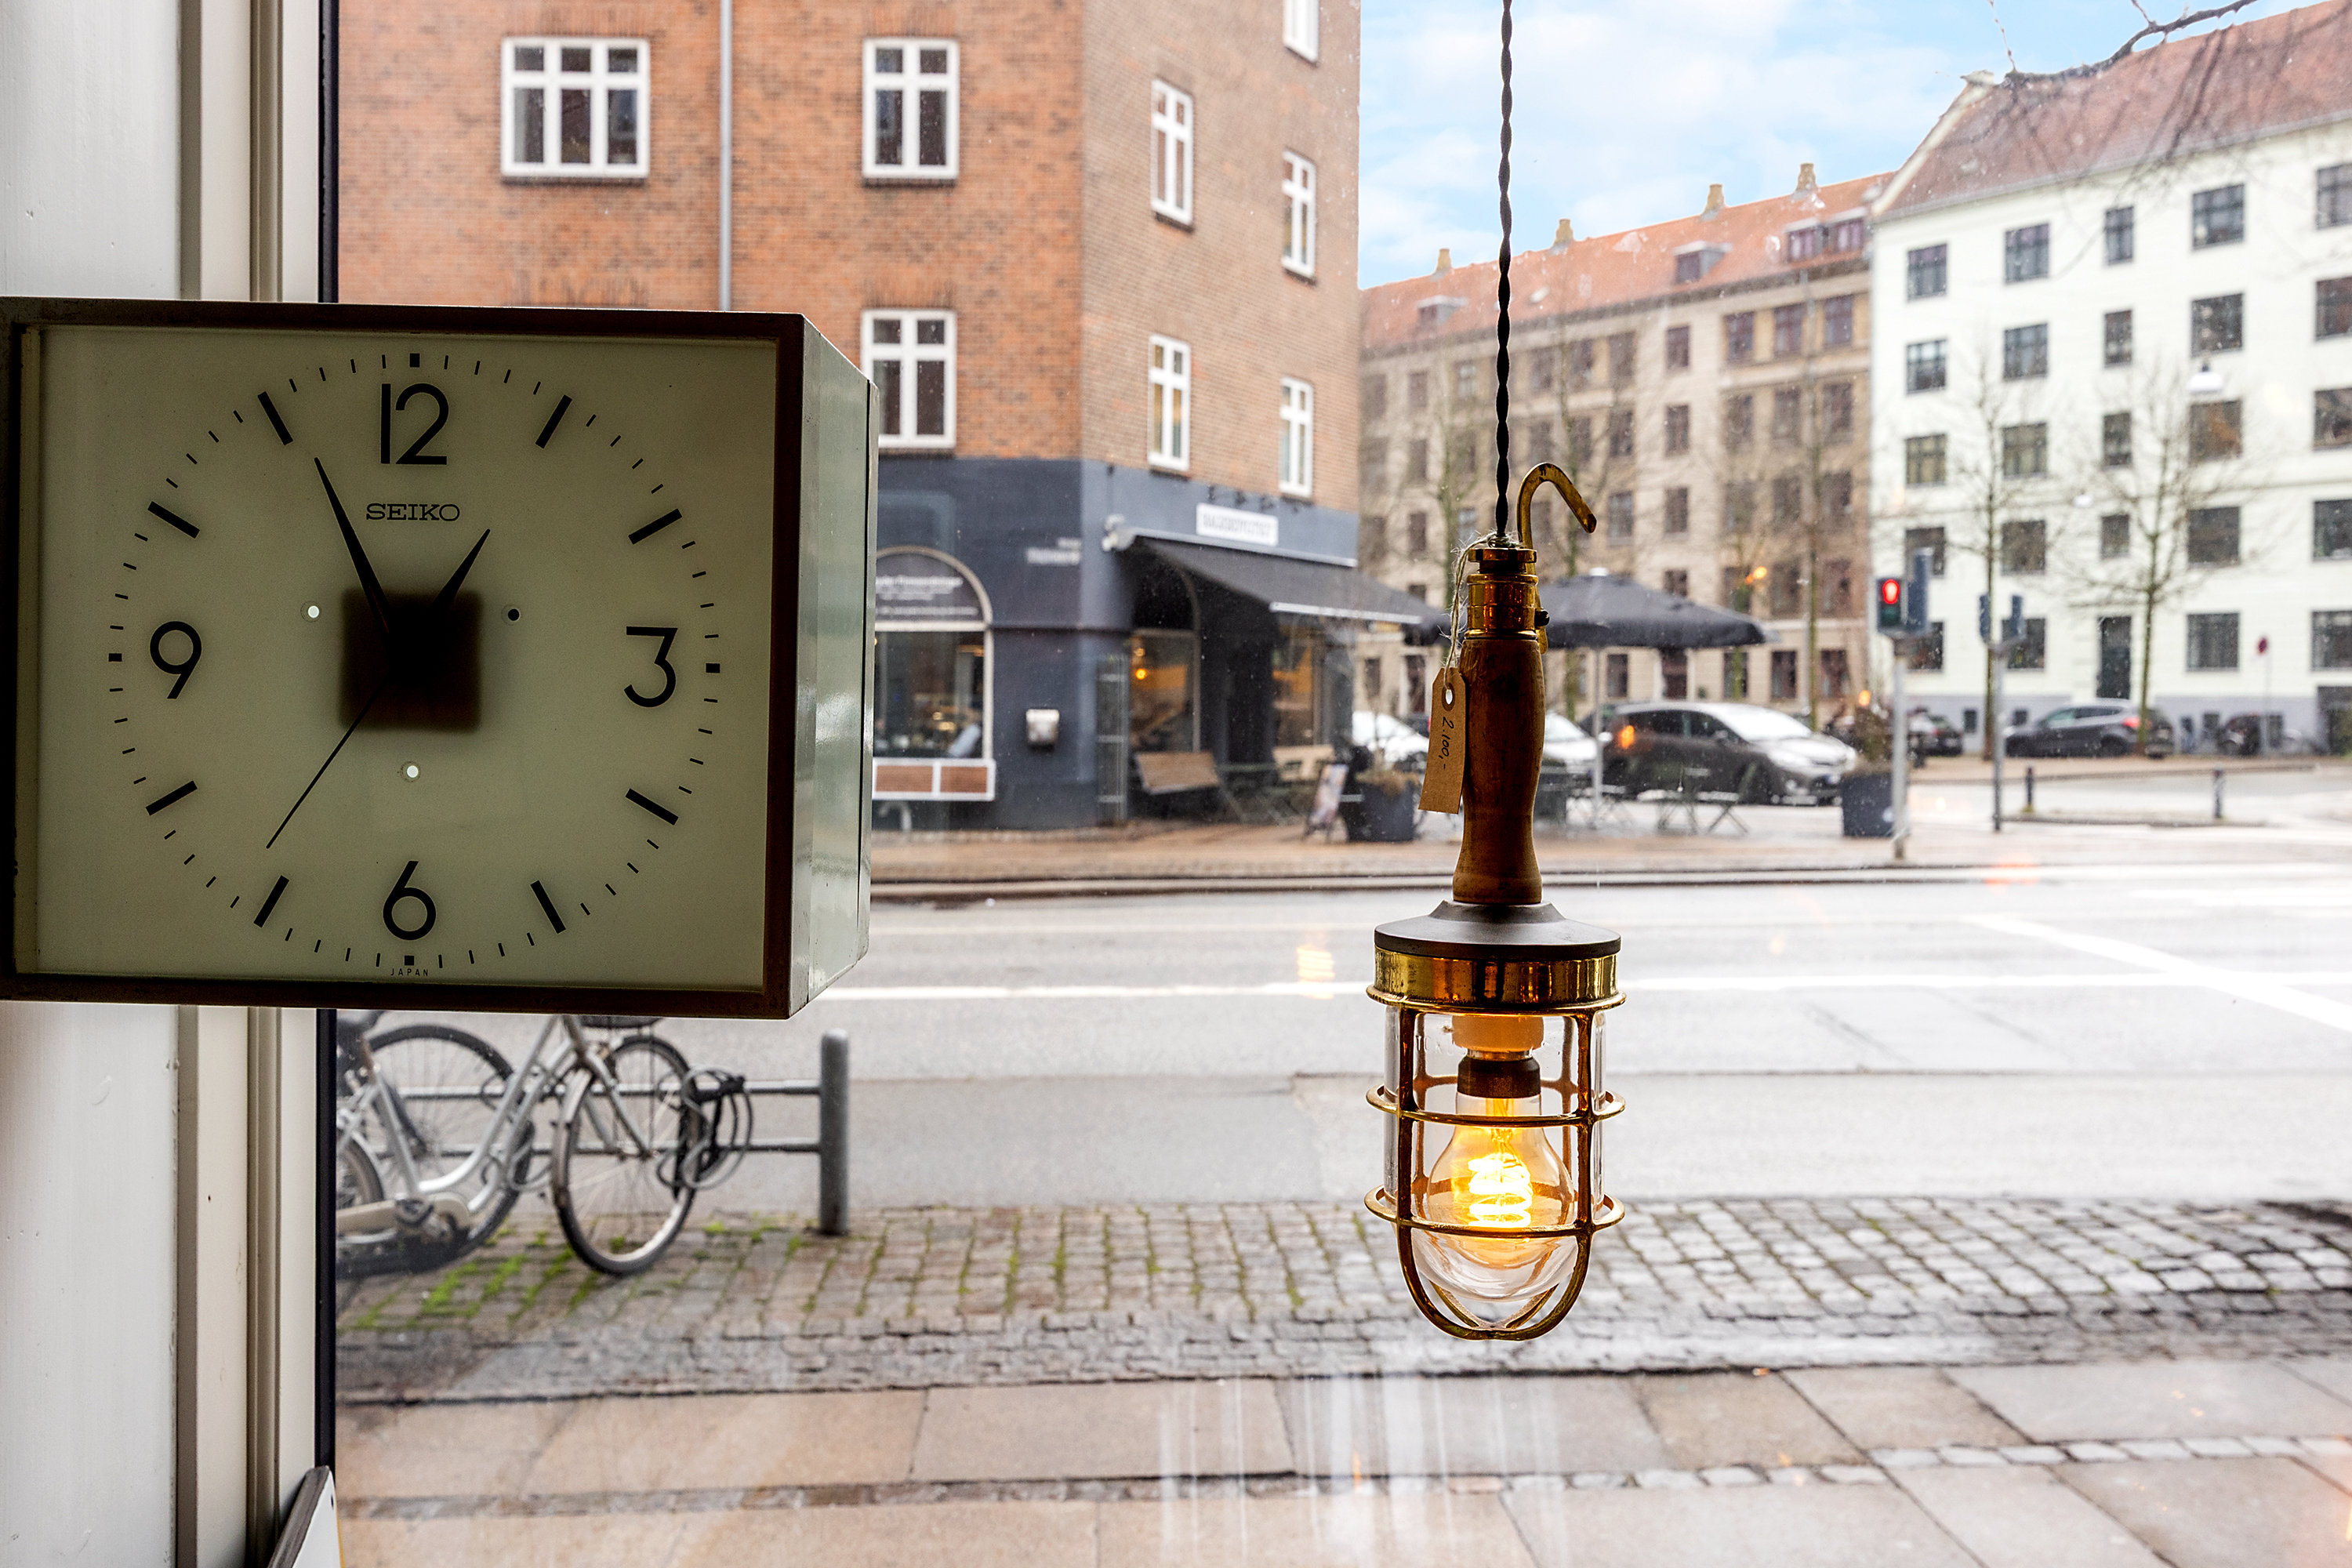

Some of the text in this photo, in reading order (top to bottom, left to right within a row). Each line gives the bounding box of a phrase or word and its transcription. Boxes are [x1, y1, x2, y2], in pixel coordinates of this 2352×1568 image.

[380, 383, 449, 466] 12
[366, 503, 460, 522] SEIKO
[150, 620, 202, 699] 9
[623, 626, 678, 708] 3
[383, 860, 437, 941] 6
[390, 967, 429, 977] JAPAN
